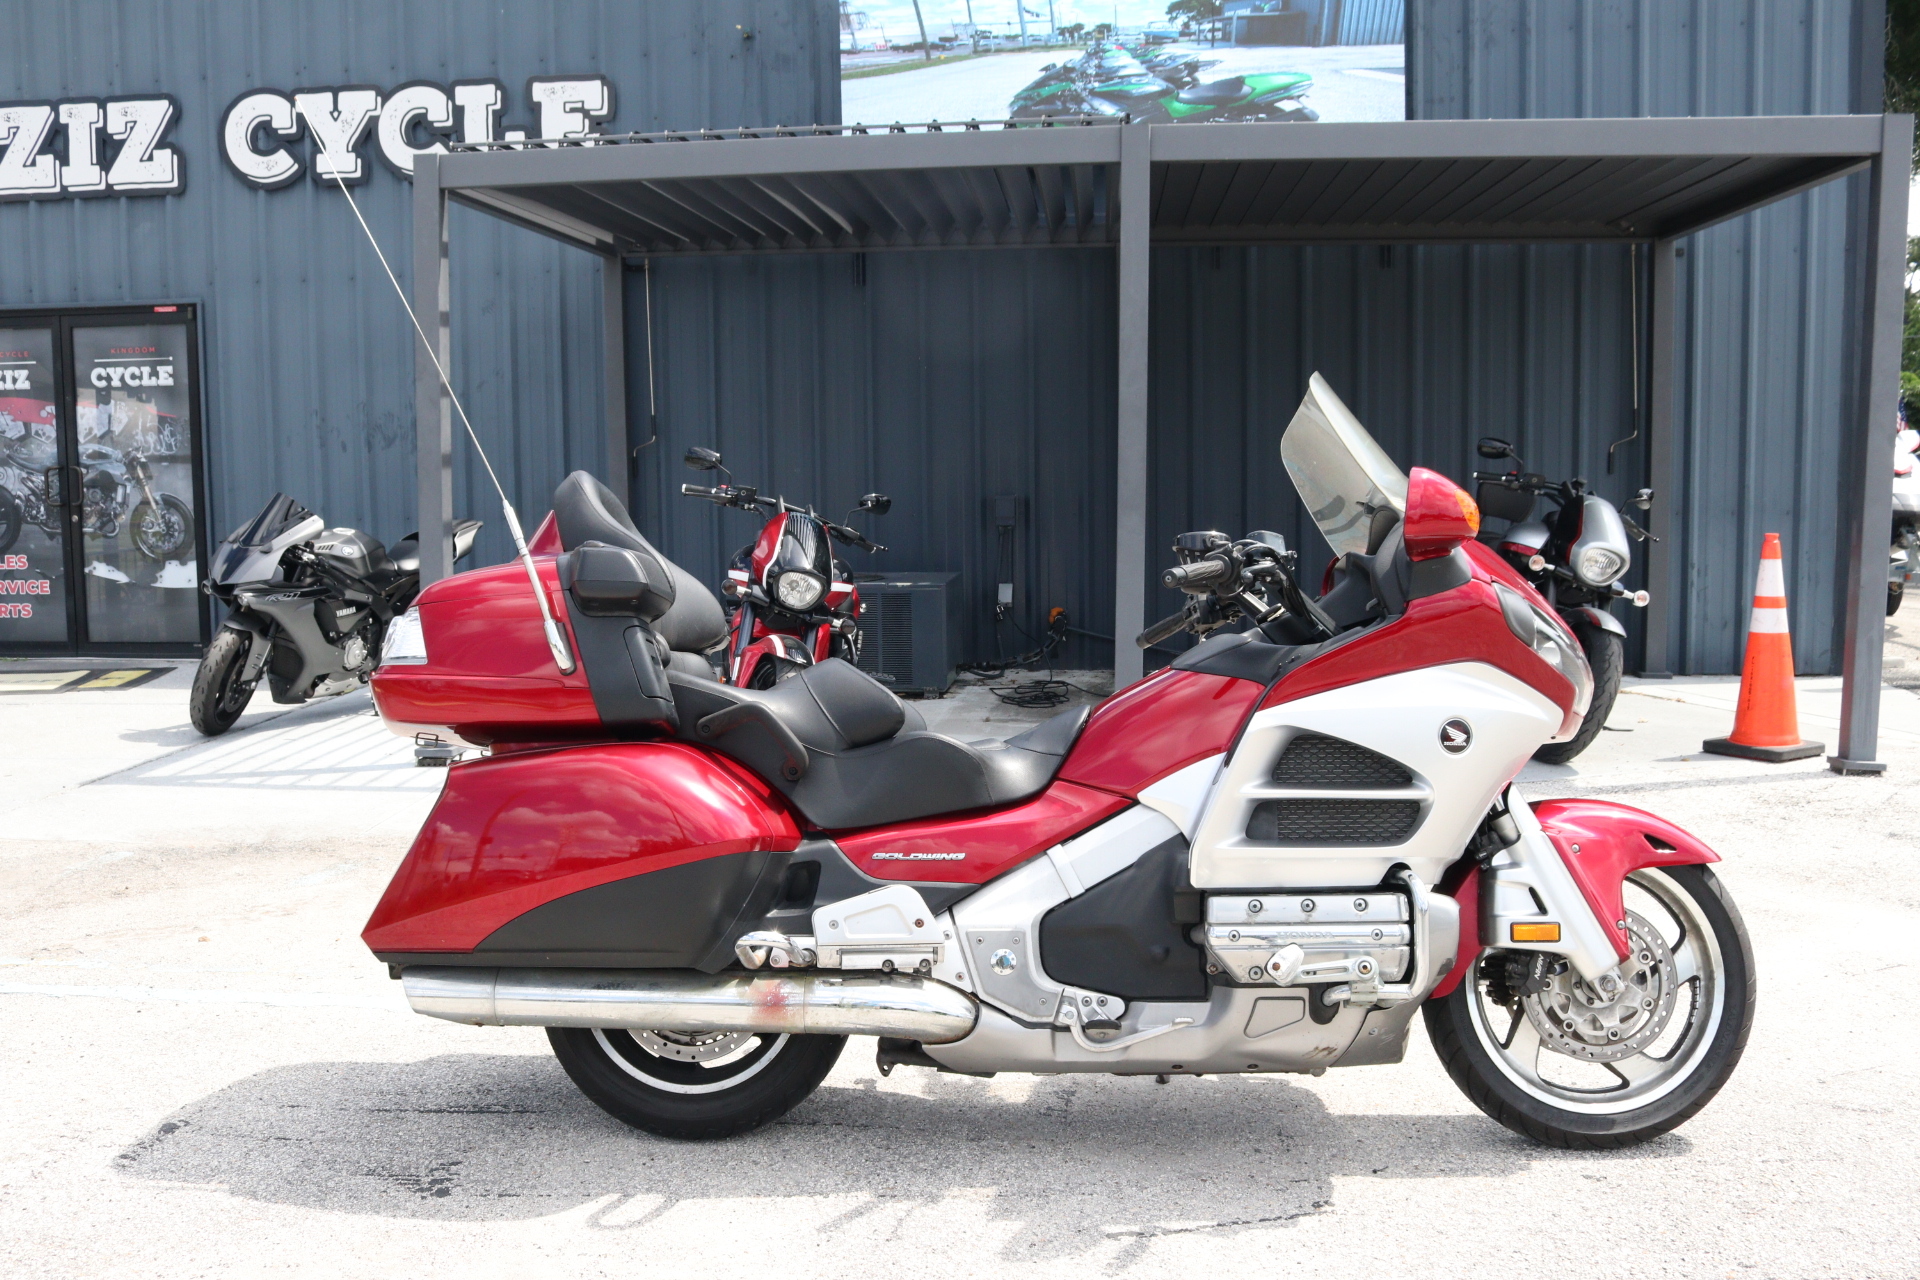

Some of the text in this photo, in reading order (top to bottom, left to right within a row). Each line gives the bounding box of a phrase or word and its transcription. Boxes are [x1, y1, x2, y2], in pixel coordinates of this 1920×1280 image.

[221, 77, 611, 186] CYCLE
[110, 346, 156, 354] KINGDOM
[0, 369, 31, 390] IZ
[90, 365, 174, 388] CYCLE
[872, 852, 966, 861] GOLDWING
[1275, 931, 1335, 940] HONDA
